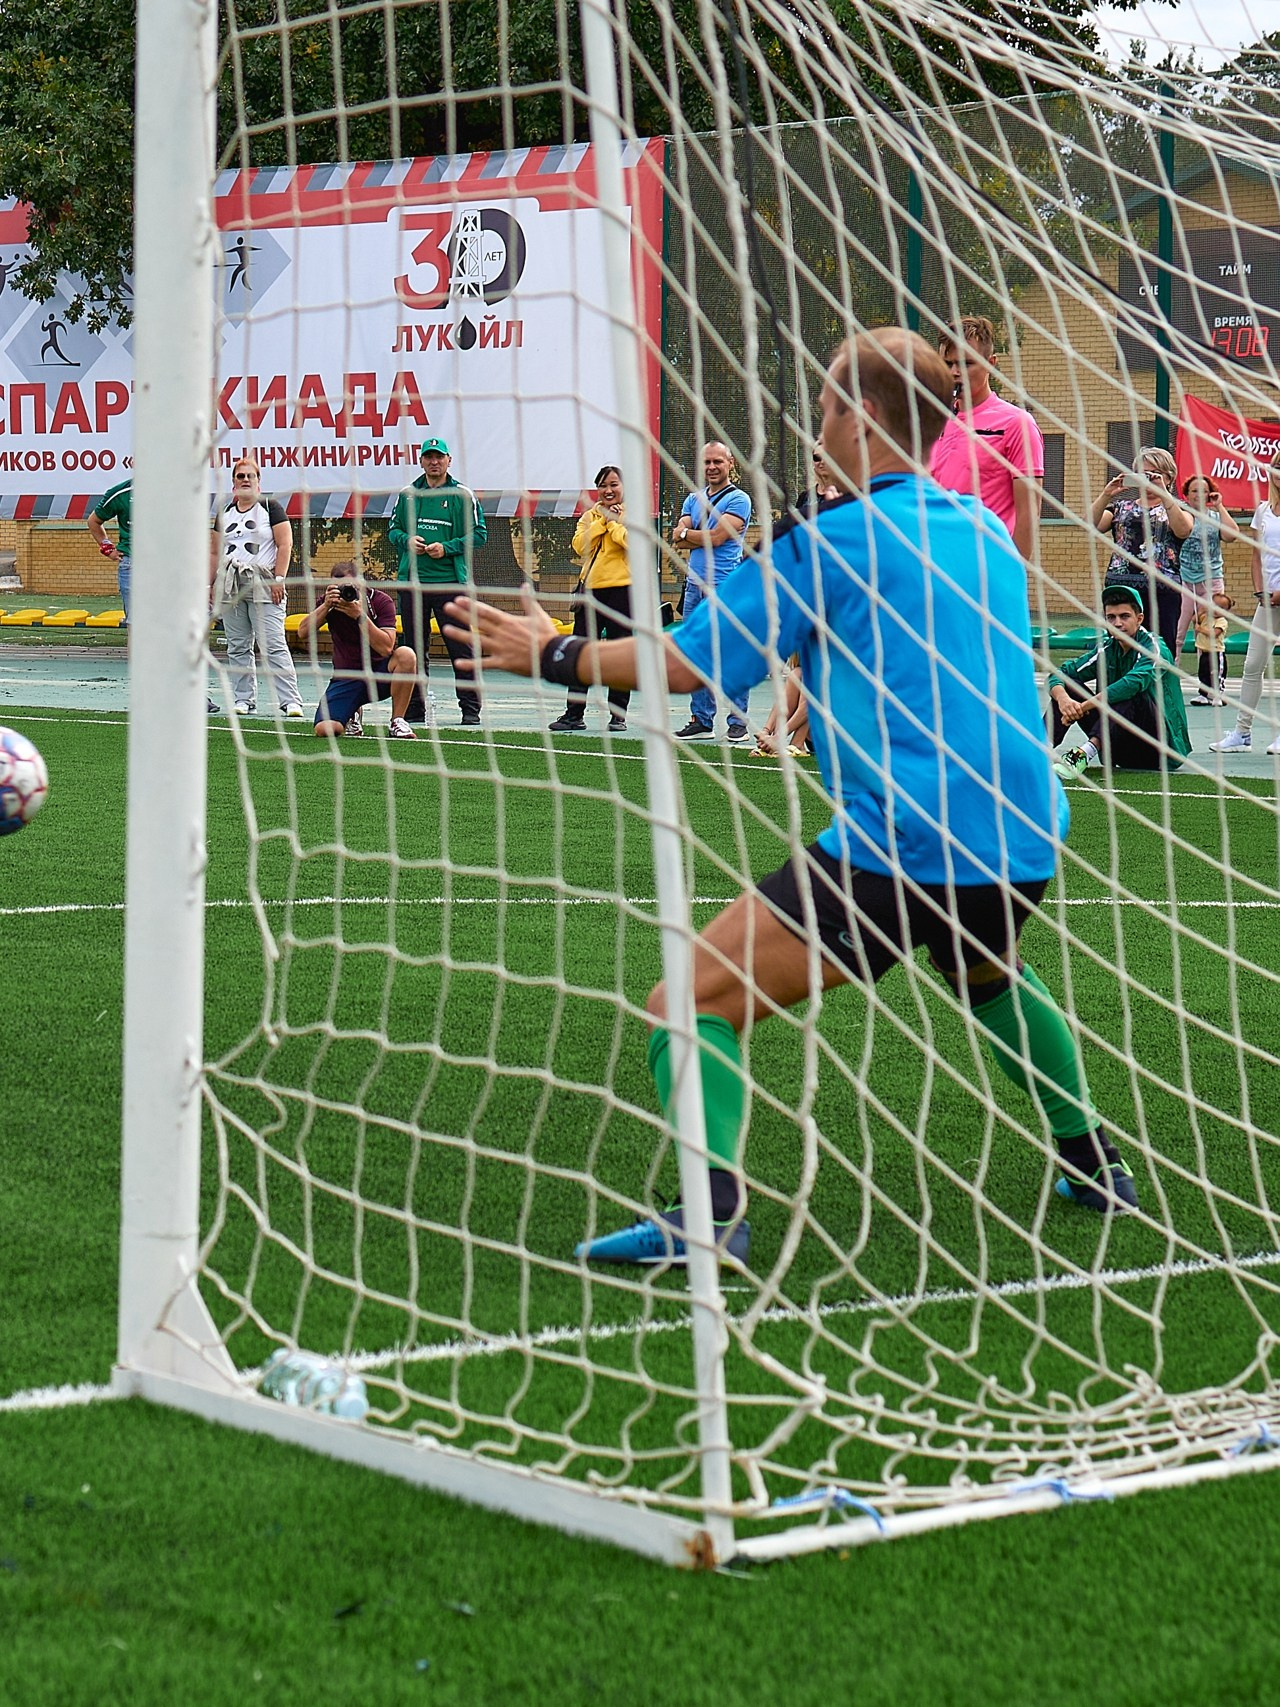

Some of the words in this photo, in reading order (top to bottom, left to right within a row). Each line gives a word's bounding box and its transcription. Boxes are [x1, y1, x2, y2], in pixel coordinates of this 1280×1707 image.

[484, 251, 504, 262] ЛЕТ
[1219, 263, 1252, 276] ТАЙМ
[1214, 316, 1253, 327] ВРЕМЯ
[62, 449, 116, 471] ООО
[1211, 457, 1244, 480] МЫ
[1247, 461, 1272, 483] ВС
